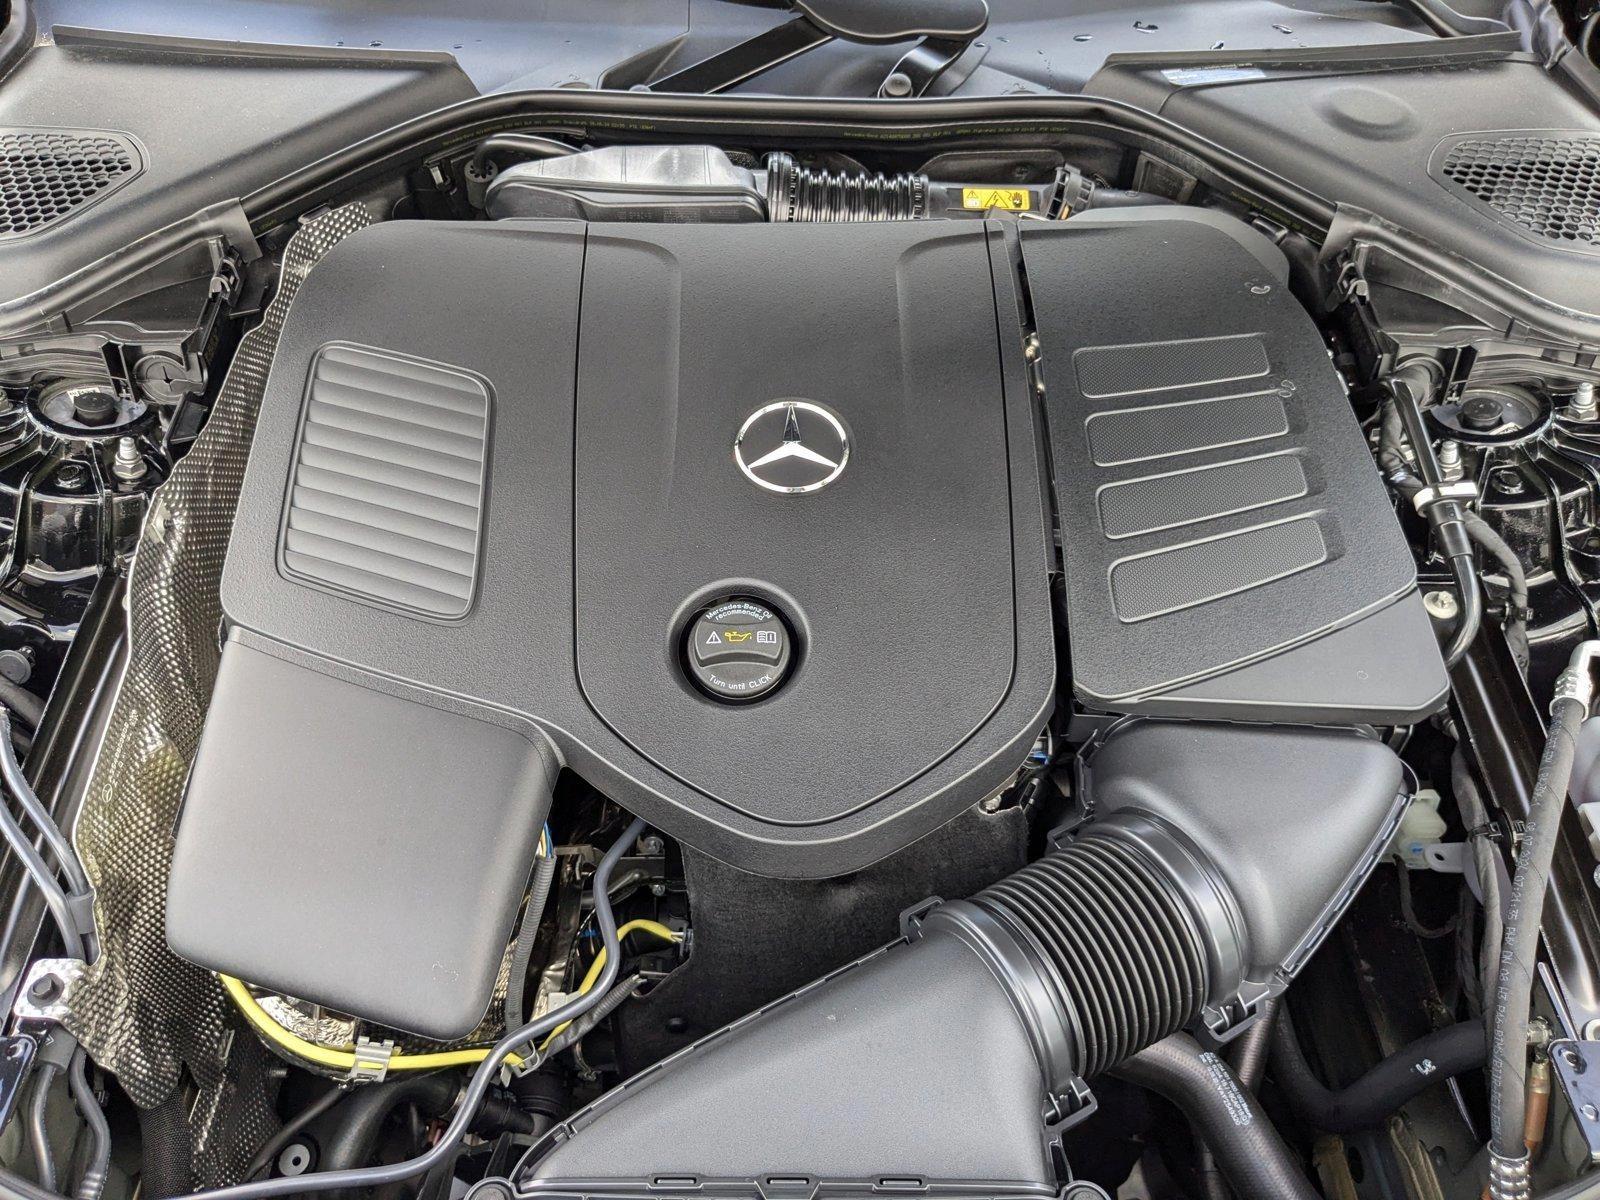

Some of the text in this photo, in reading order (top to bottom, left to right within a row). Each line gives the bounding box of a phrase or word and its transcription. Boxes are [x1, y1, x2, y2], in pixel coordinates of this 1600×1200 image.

[705, 603, 773, 620] Mercedes-Benz Oil
[715, 609, 765, 621] recommended
[709, 673, 772, 690] Turn until CLICK
